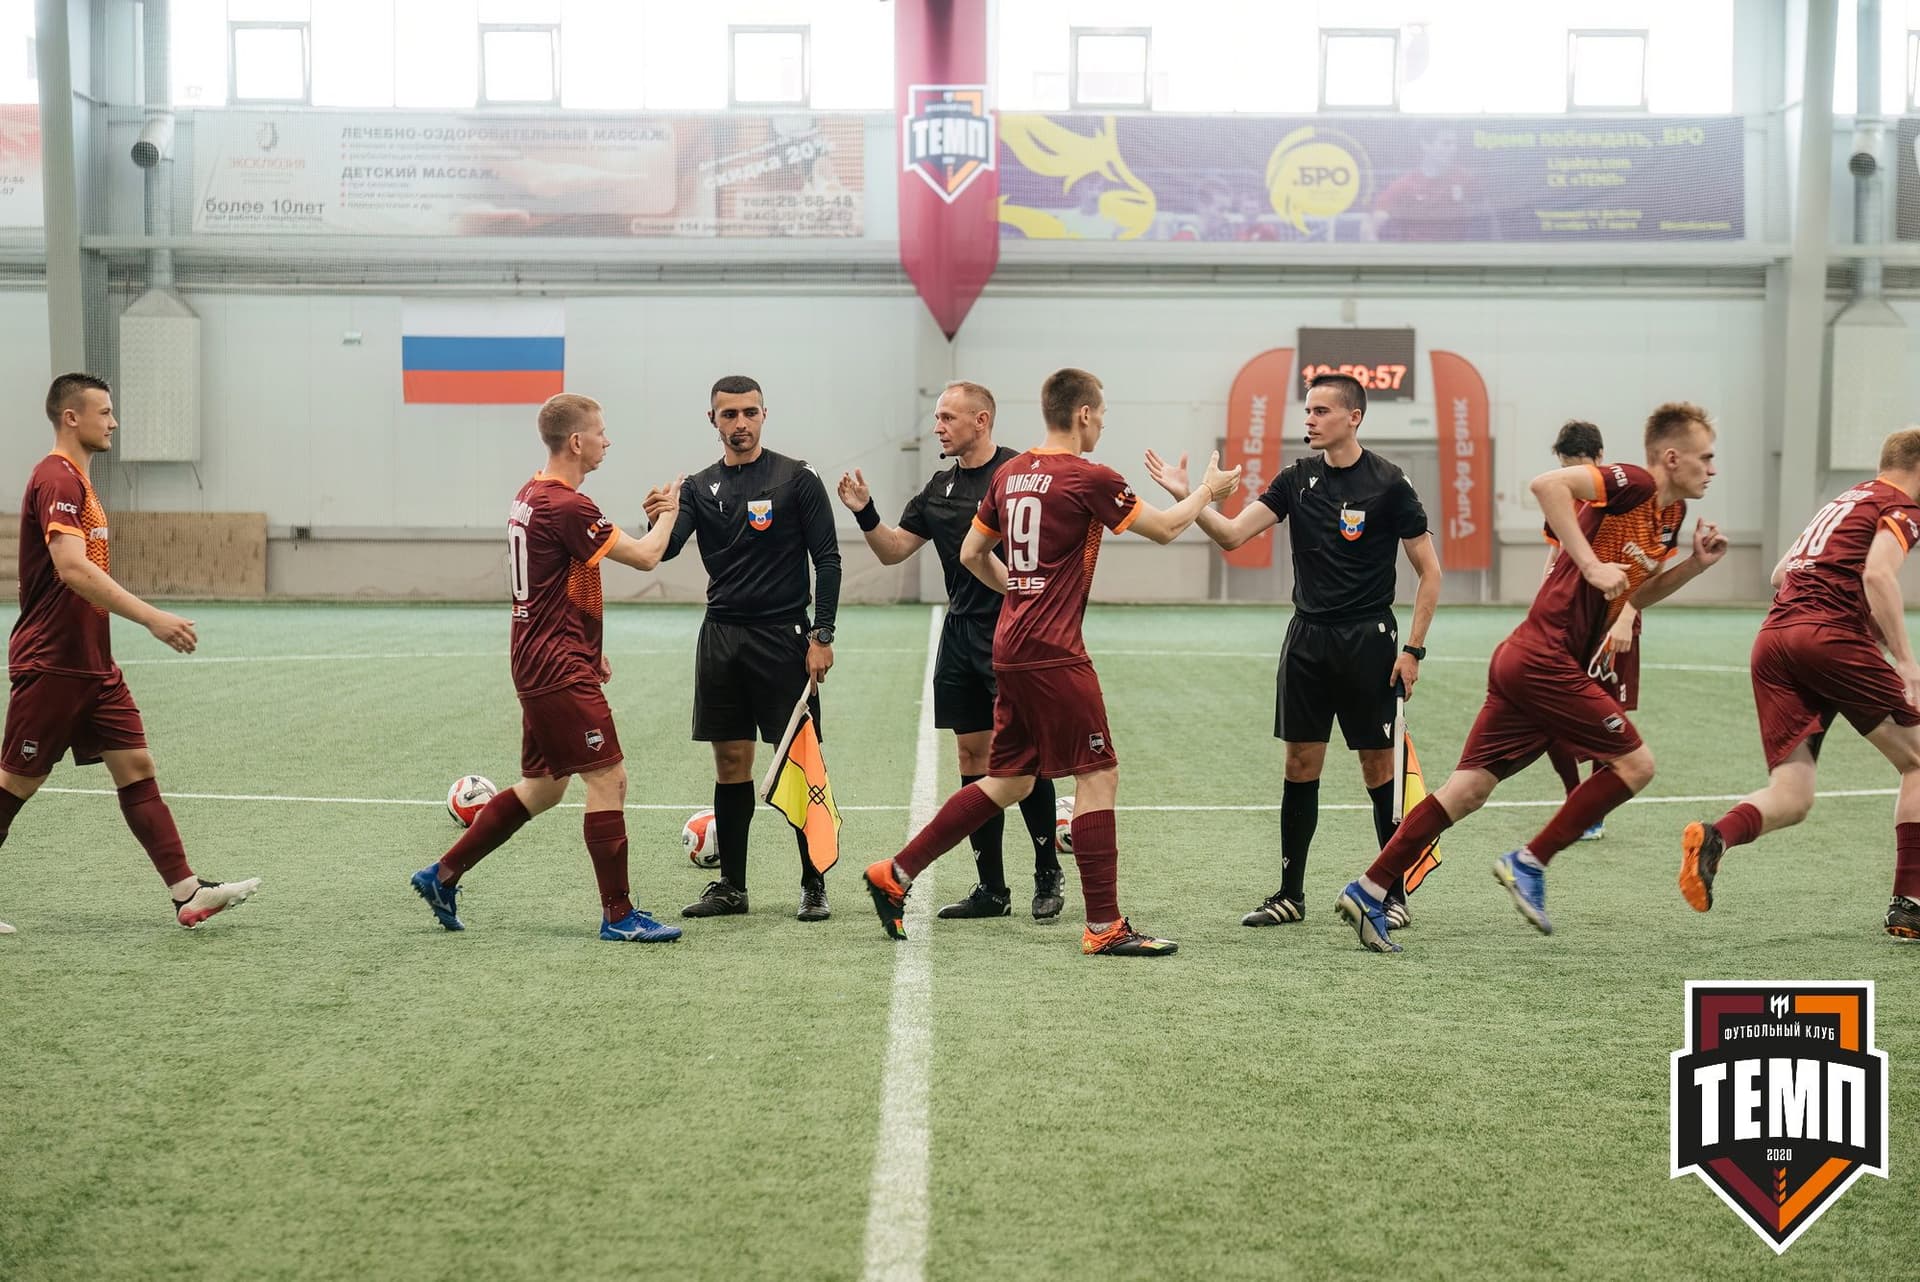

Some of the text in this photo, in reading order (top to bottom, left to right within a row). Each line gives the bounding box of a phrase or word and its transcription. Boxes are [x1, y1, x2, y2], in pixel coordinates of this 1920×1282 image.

[912, 117, 986, 158] ТЕМП
[341, 165, 417, 180] ДЕТСКИЙ
[205, 196, 265, 214] более
[1006, 473, 1053, 495] ШИБАЕВ
[56, 501, 78, 514] ПСБ
[1006, 496, 1042, 572] 19
[1007, 577, 1046, 590] EUS
